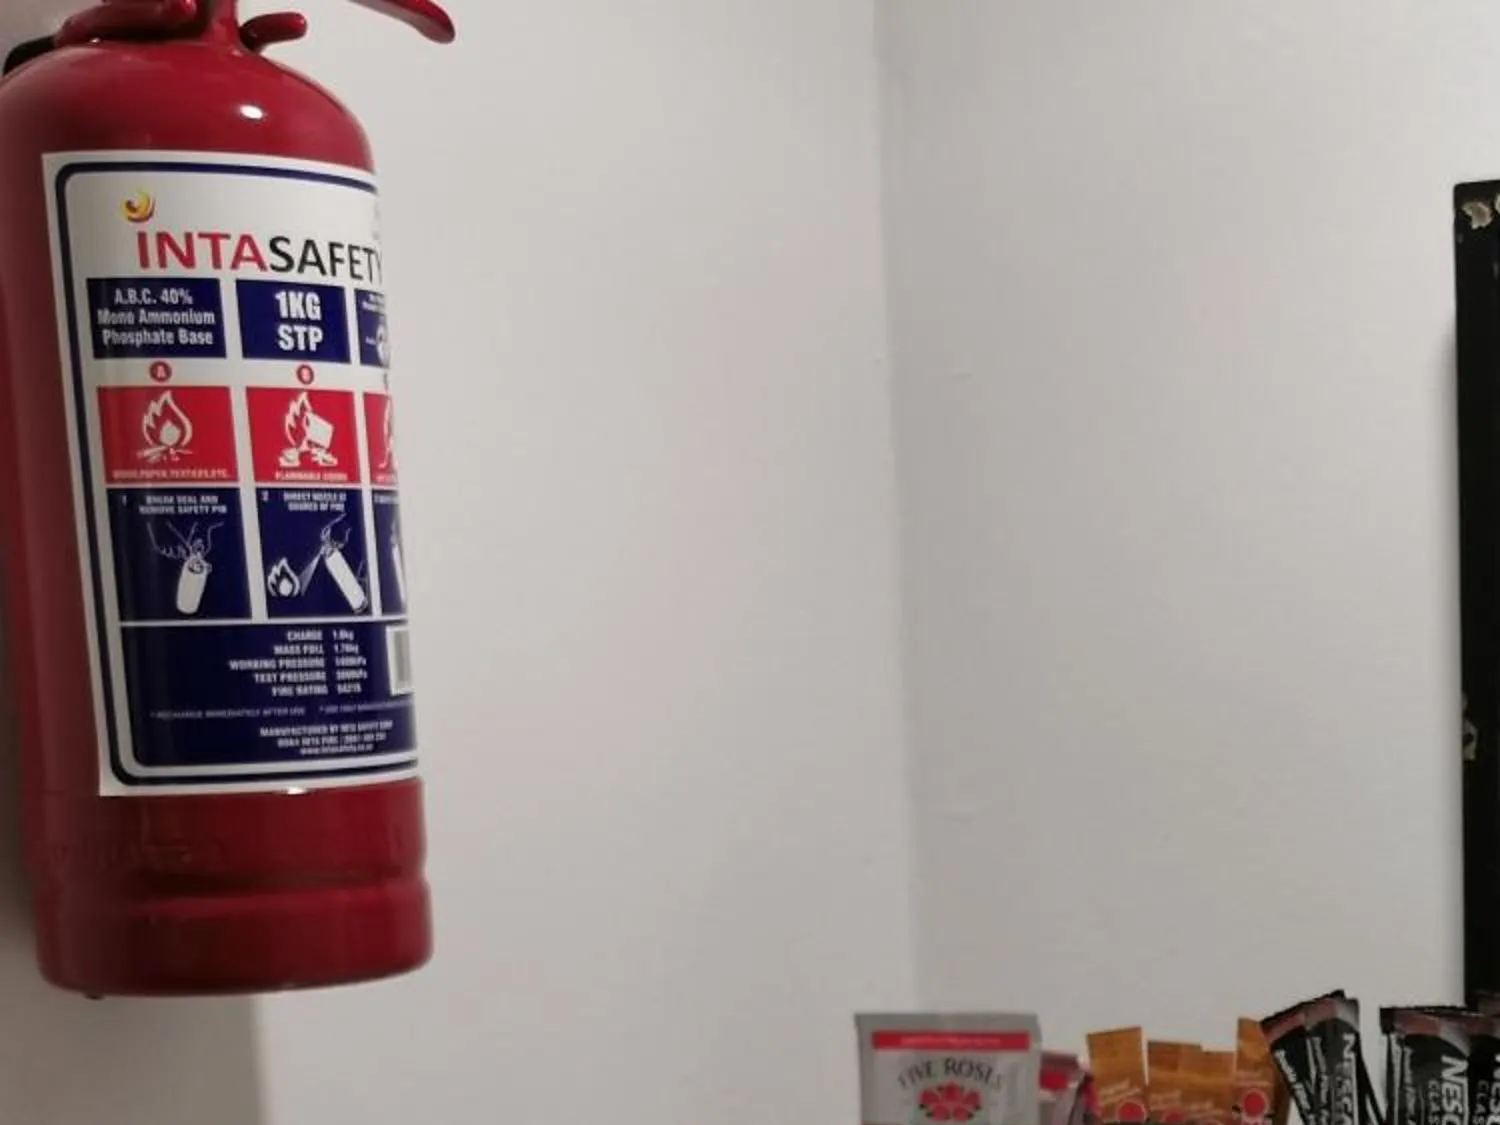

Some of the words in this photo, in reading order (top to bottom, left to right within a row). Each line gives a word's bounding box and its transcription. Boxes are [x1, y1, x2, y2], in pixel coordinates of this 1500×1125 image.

[137, 231, 383, 286] INTASAFETY
[115, 288, 157, 305] A.B.C.
[160, 287, 193, 305] 40%
[274, 290, 322, 321] 1KG
[139, 308, 216, 325] Ammonium
[102, 328, 175, 348] Phosphate
[178, 327, 213, 345] Base
[277, 324, 323, 352] STP
